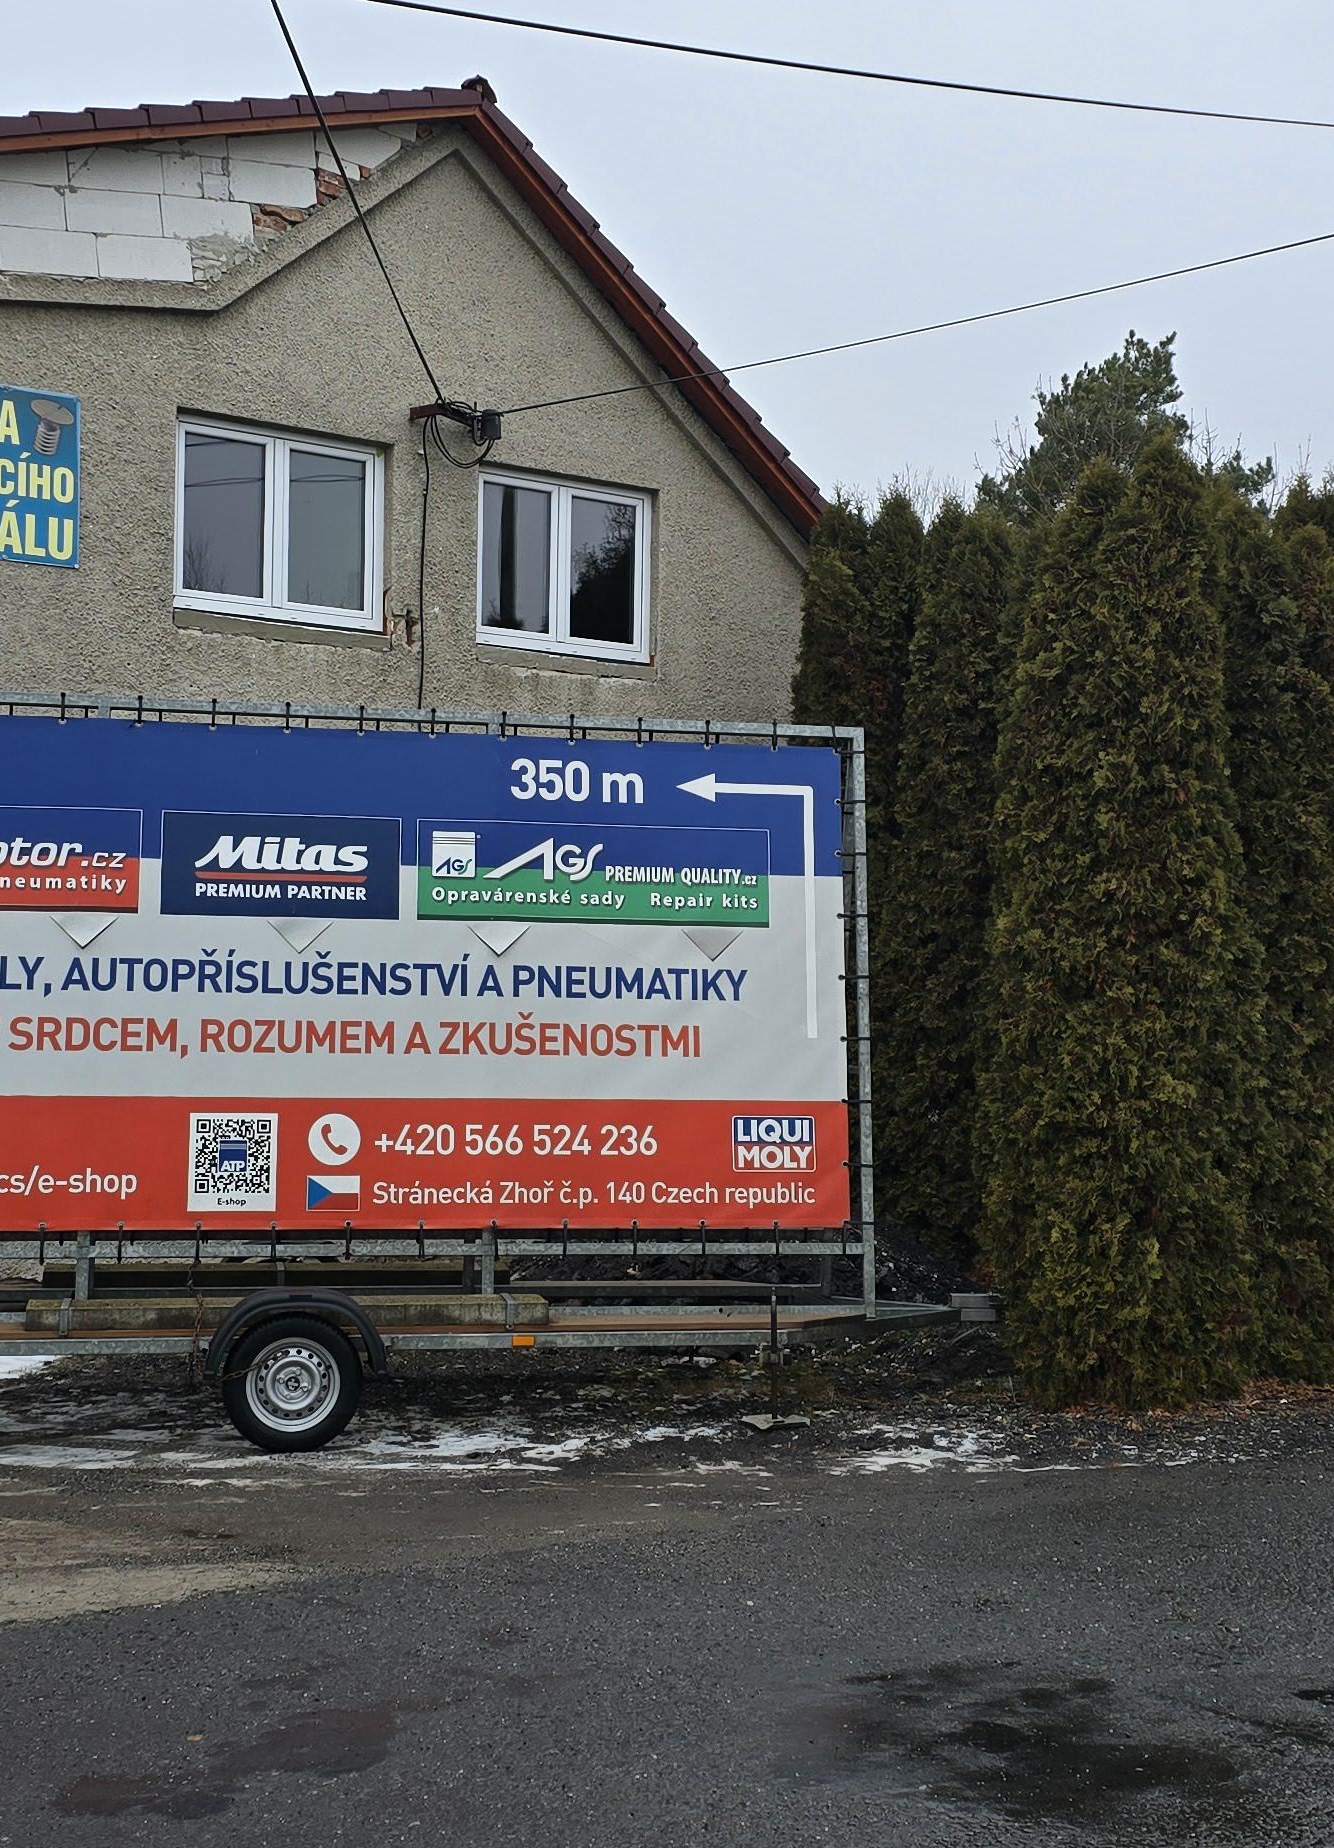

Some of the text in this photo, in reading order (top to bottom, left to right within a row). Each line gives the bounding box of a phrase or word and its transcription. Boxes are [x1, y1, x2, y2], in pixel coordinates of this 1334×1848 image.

[510, 758, 644, 804] 350 m
[194, 835, 369, 873] Mitas
[435, 857, 473, 875] AGS
[482, 837, 604, 881] AGS
[605, 865, 675, 883] PREMIUM
[195, 882, 367, 901] PREMIUM PARTNER
[431, 886, 758, 910] Opravárenské sady Repair kits
[61, 948, 470, 997] AUTOPŘÍSLUŠENSTVÍ
[476, 964, 504, 997] A
[512, 964, 748, 1001] PNEUMATIKY
[8, 1016, 189, 1059] SRDCEM,
[200, 1018, 395, 1055] ROZUMEM
[403, 1021, 431, 1055] A
[438, 1011, 701, 1058] ZKUŠENOSTMI
[374, 1123, 658, 1156] +420 566 524 236
[737, 1118, 810, 1144] LIQUI
[220, 1160, 246, 1172] ATP
[737, 1145, 813, 1169] MOLY
[217, 1197, 247, 1207] E-shop
[372, 1179, 816, 1209] Stránecká Zhoř č.p. 140 Czech republic
